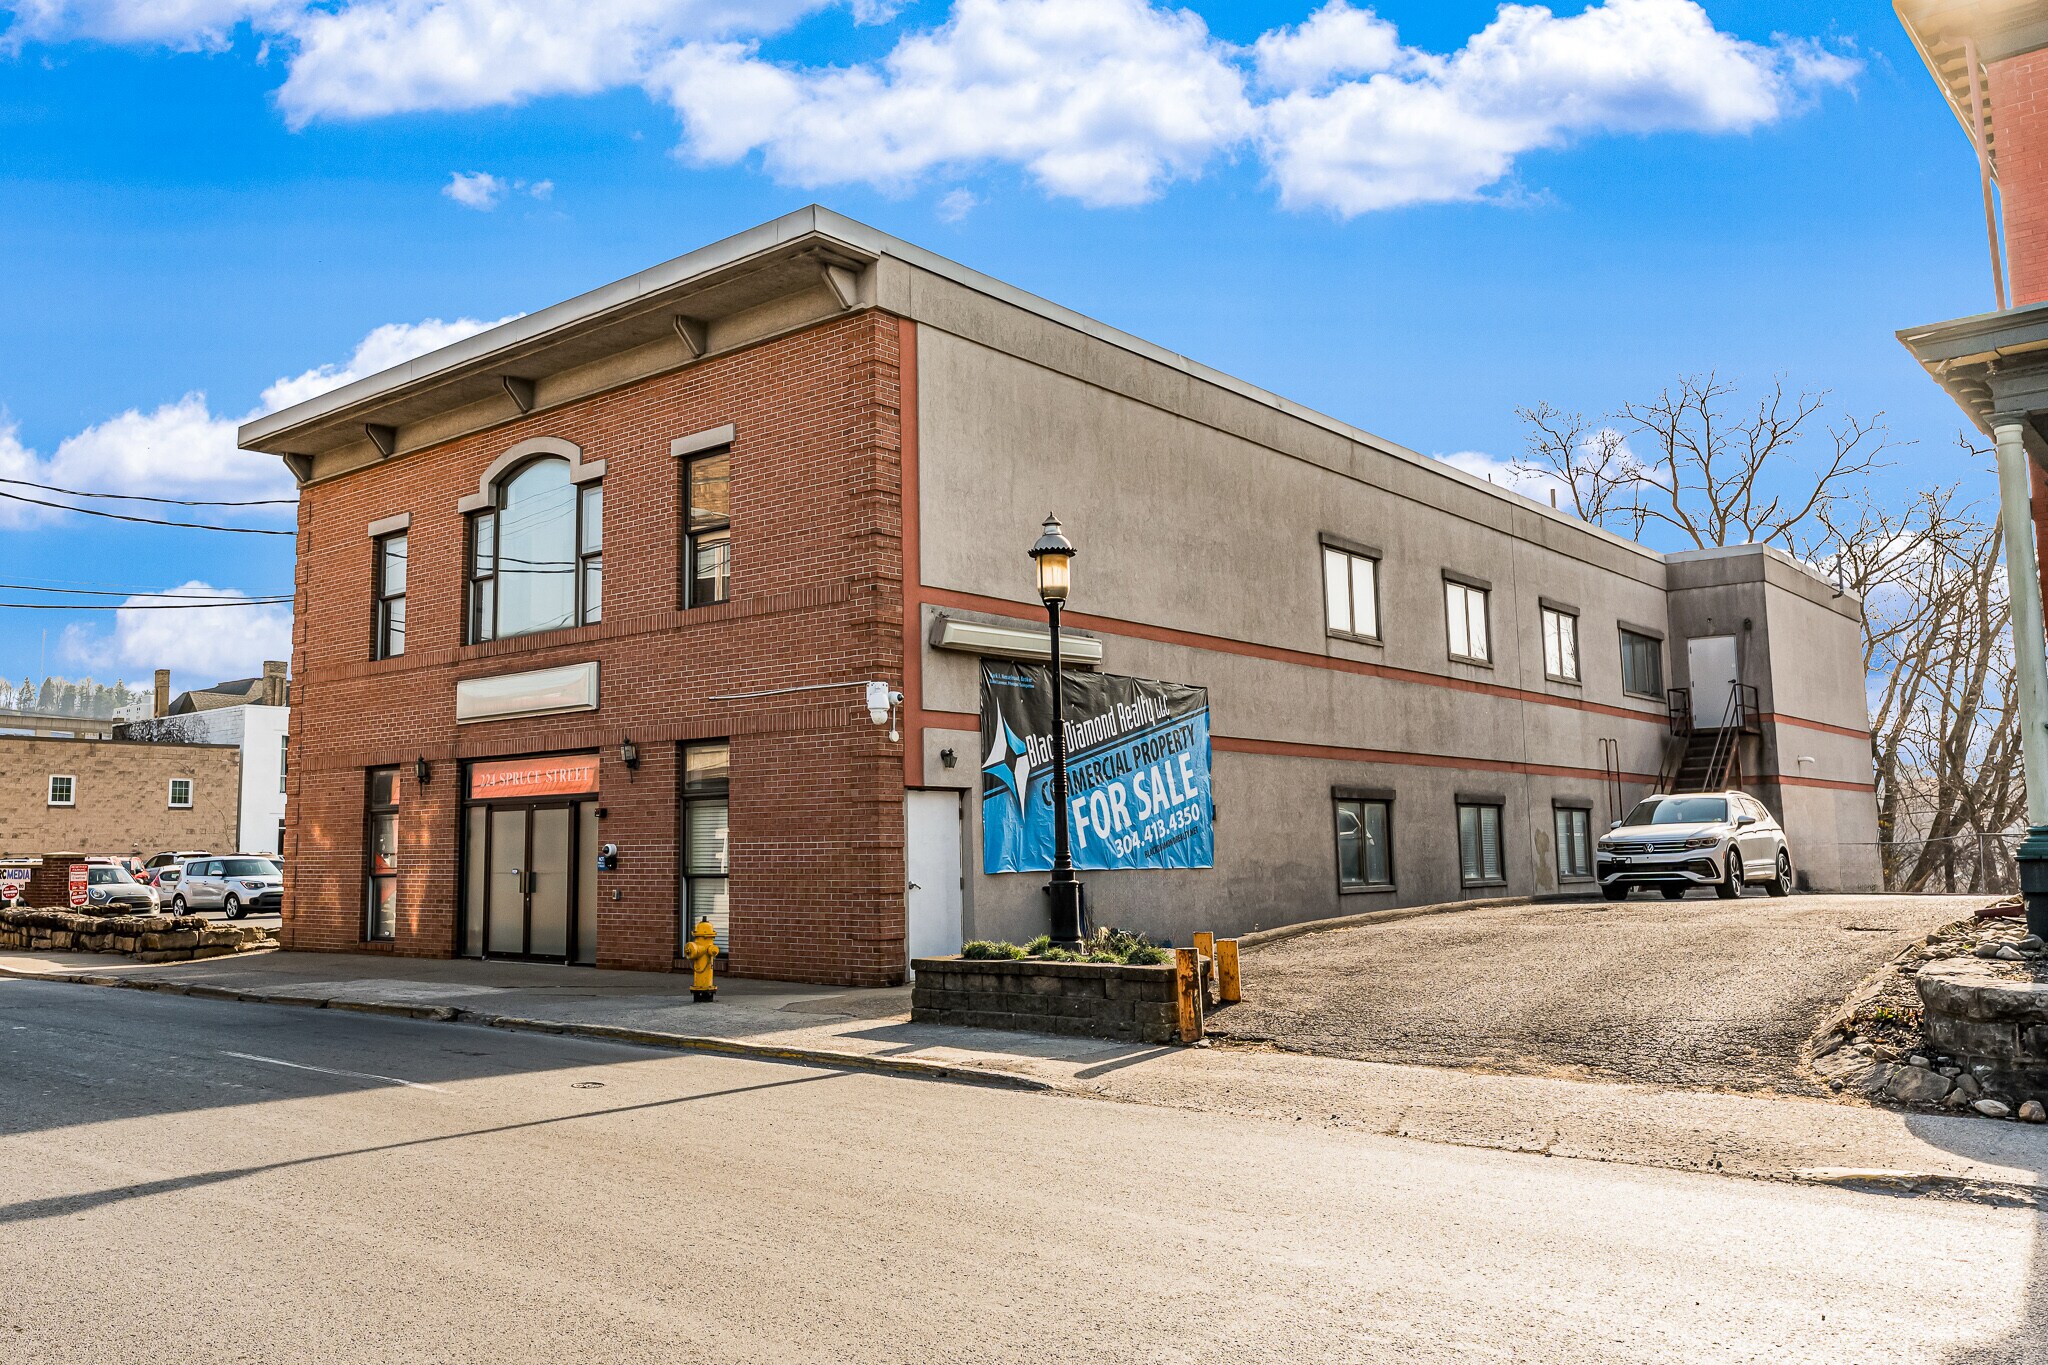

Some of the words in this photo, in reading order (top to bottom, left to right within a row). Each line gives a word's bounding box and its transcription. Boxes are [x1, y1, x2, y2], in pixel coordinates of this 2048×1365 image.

[1025, 733, 1054, 768] Blac
[1064, 705, 1118, 753] Diamond
[1117, 694, 1156, 733] Realty
[1154, 694, 1170, 719] LLC
[1132, 723, 1195, 769] PROPERTY
[480, 773, 496, 787] 224
[499, 769, 542, 786] SPRUCE
[545, 766, 590, 783] STREET
[1072, 781, 1133, 850] FOR
[1132, 751, 1199, 822] SALE
[1114, 803, 1200, 859] 304.413.4350
